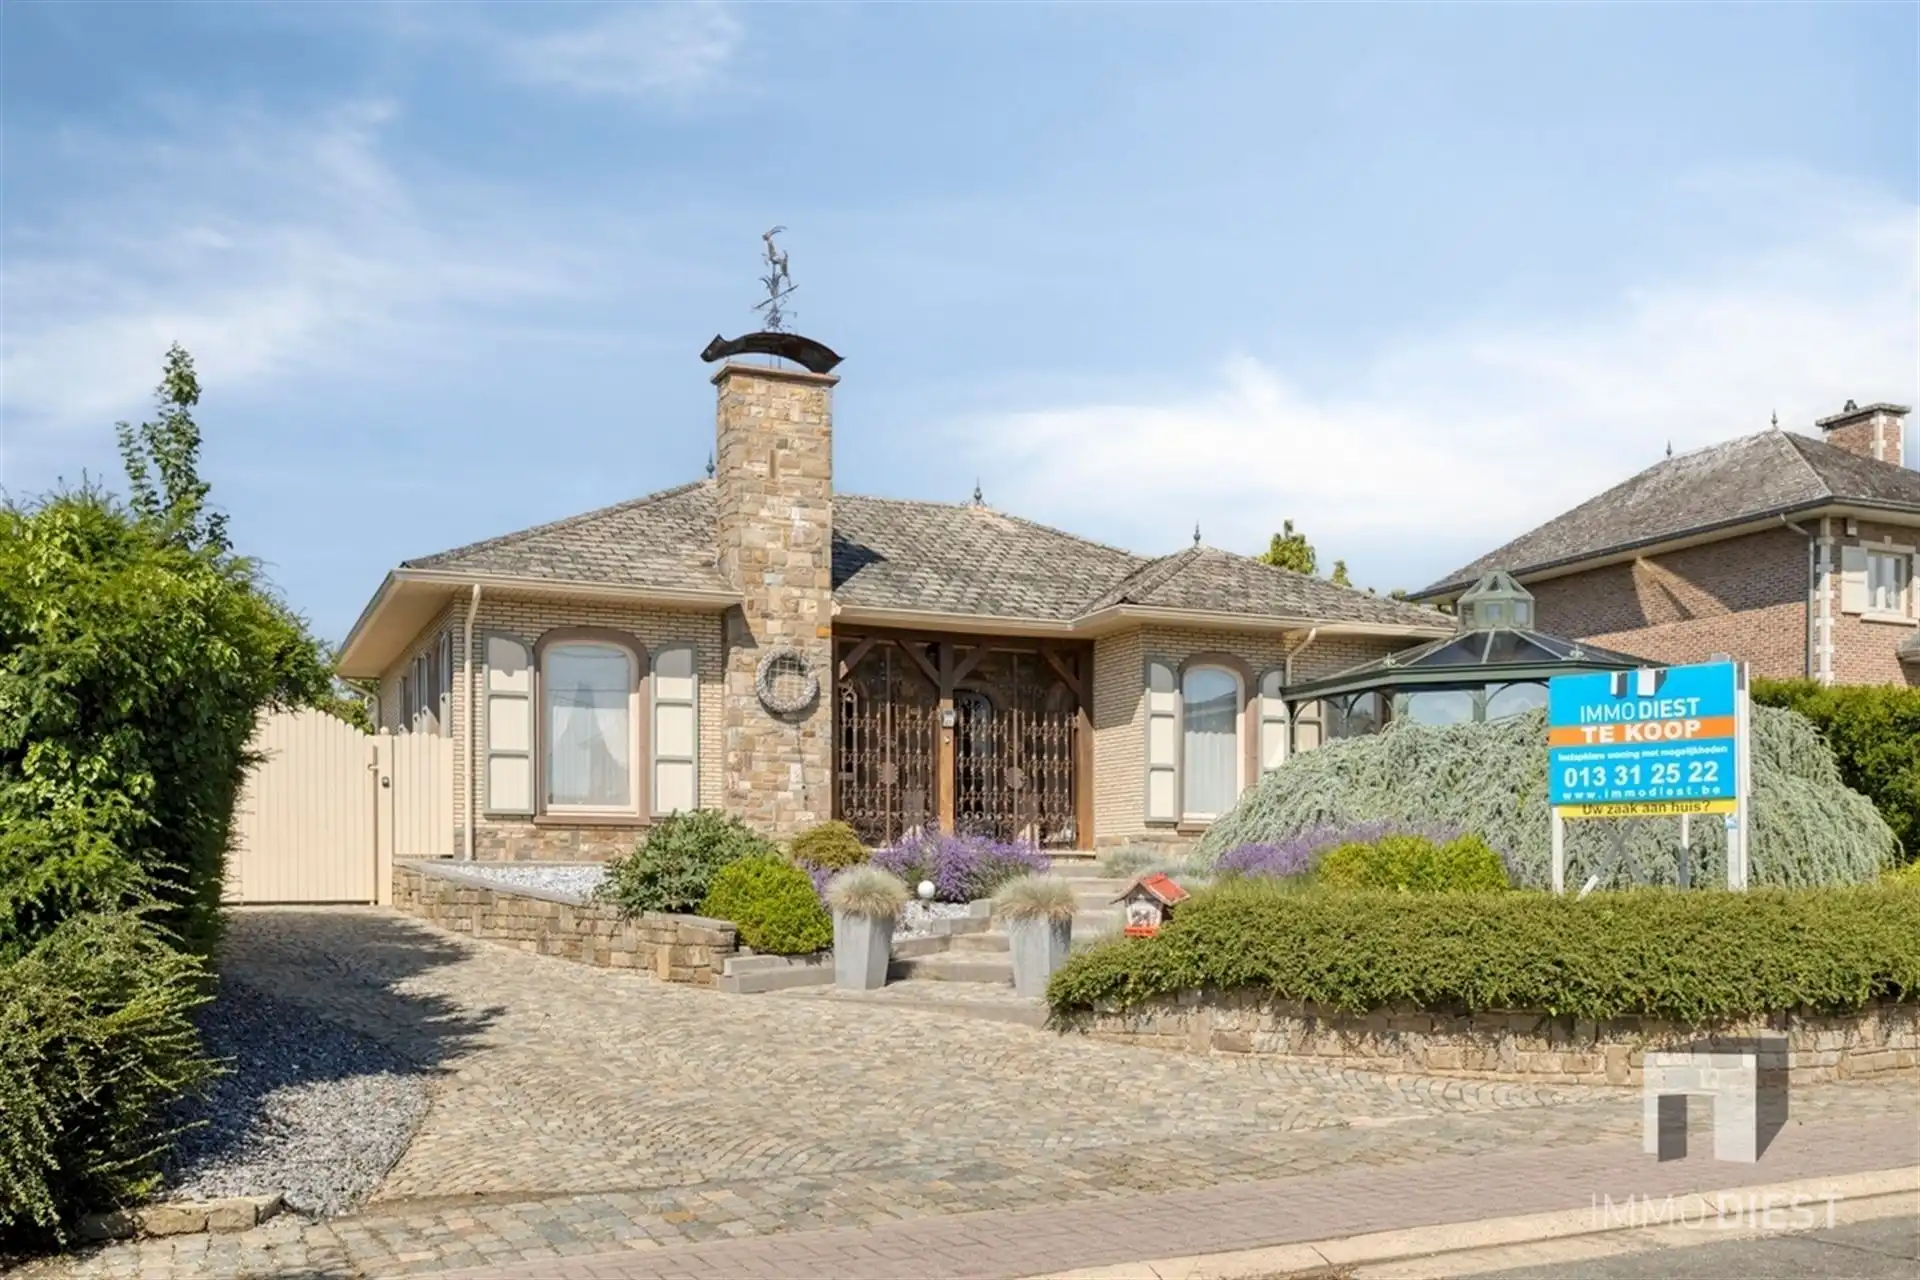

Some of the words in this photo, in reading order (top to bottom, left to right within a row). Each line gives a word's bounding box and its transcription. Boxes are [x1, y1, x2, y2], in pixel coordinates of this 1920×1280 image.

[1580, 726, 1615, 744] TE
[1624, 720, 1701, 742] KOOP
[1564, 767, 1606, 788] 013
[1614, 764, 1640, 786] 31
[1651, 762, 1680, 784] 25
[1688, 761, 1718, 783] 22
[1583, 804, 1605, 815] Uw
[1607, 802, 1637, 814] zaak
[1642, 803, 1666, 813] aan
[1671, 800, 1711, 812] huis?
